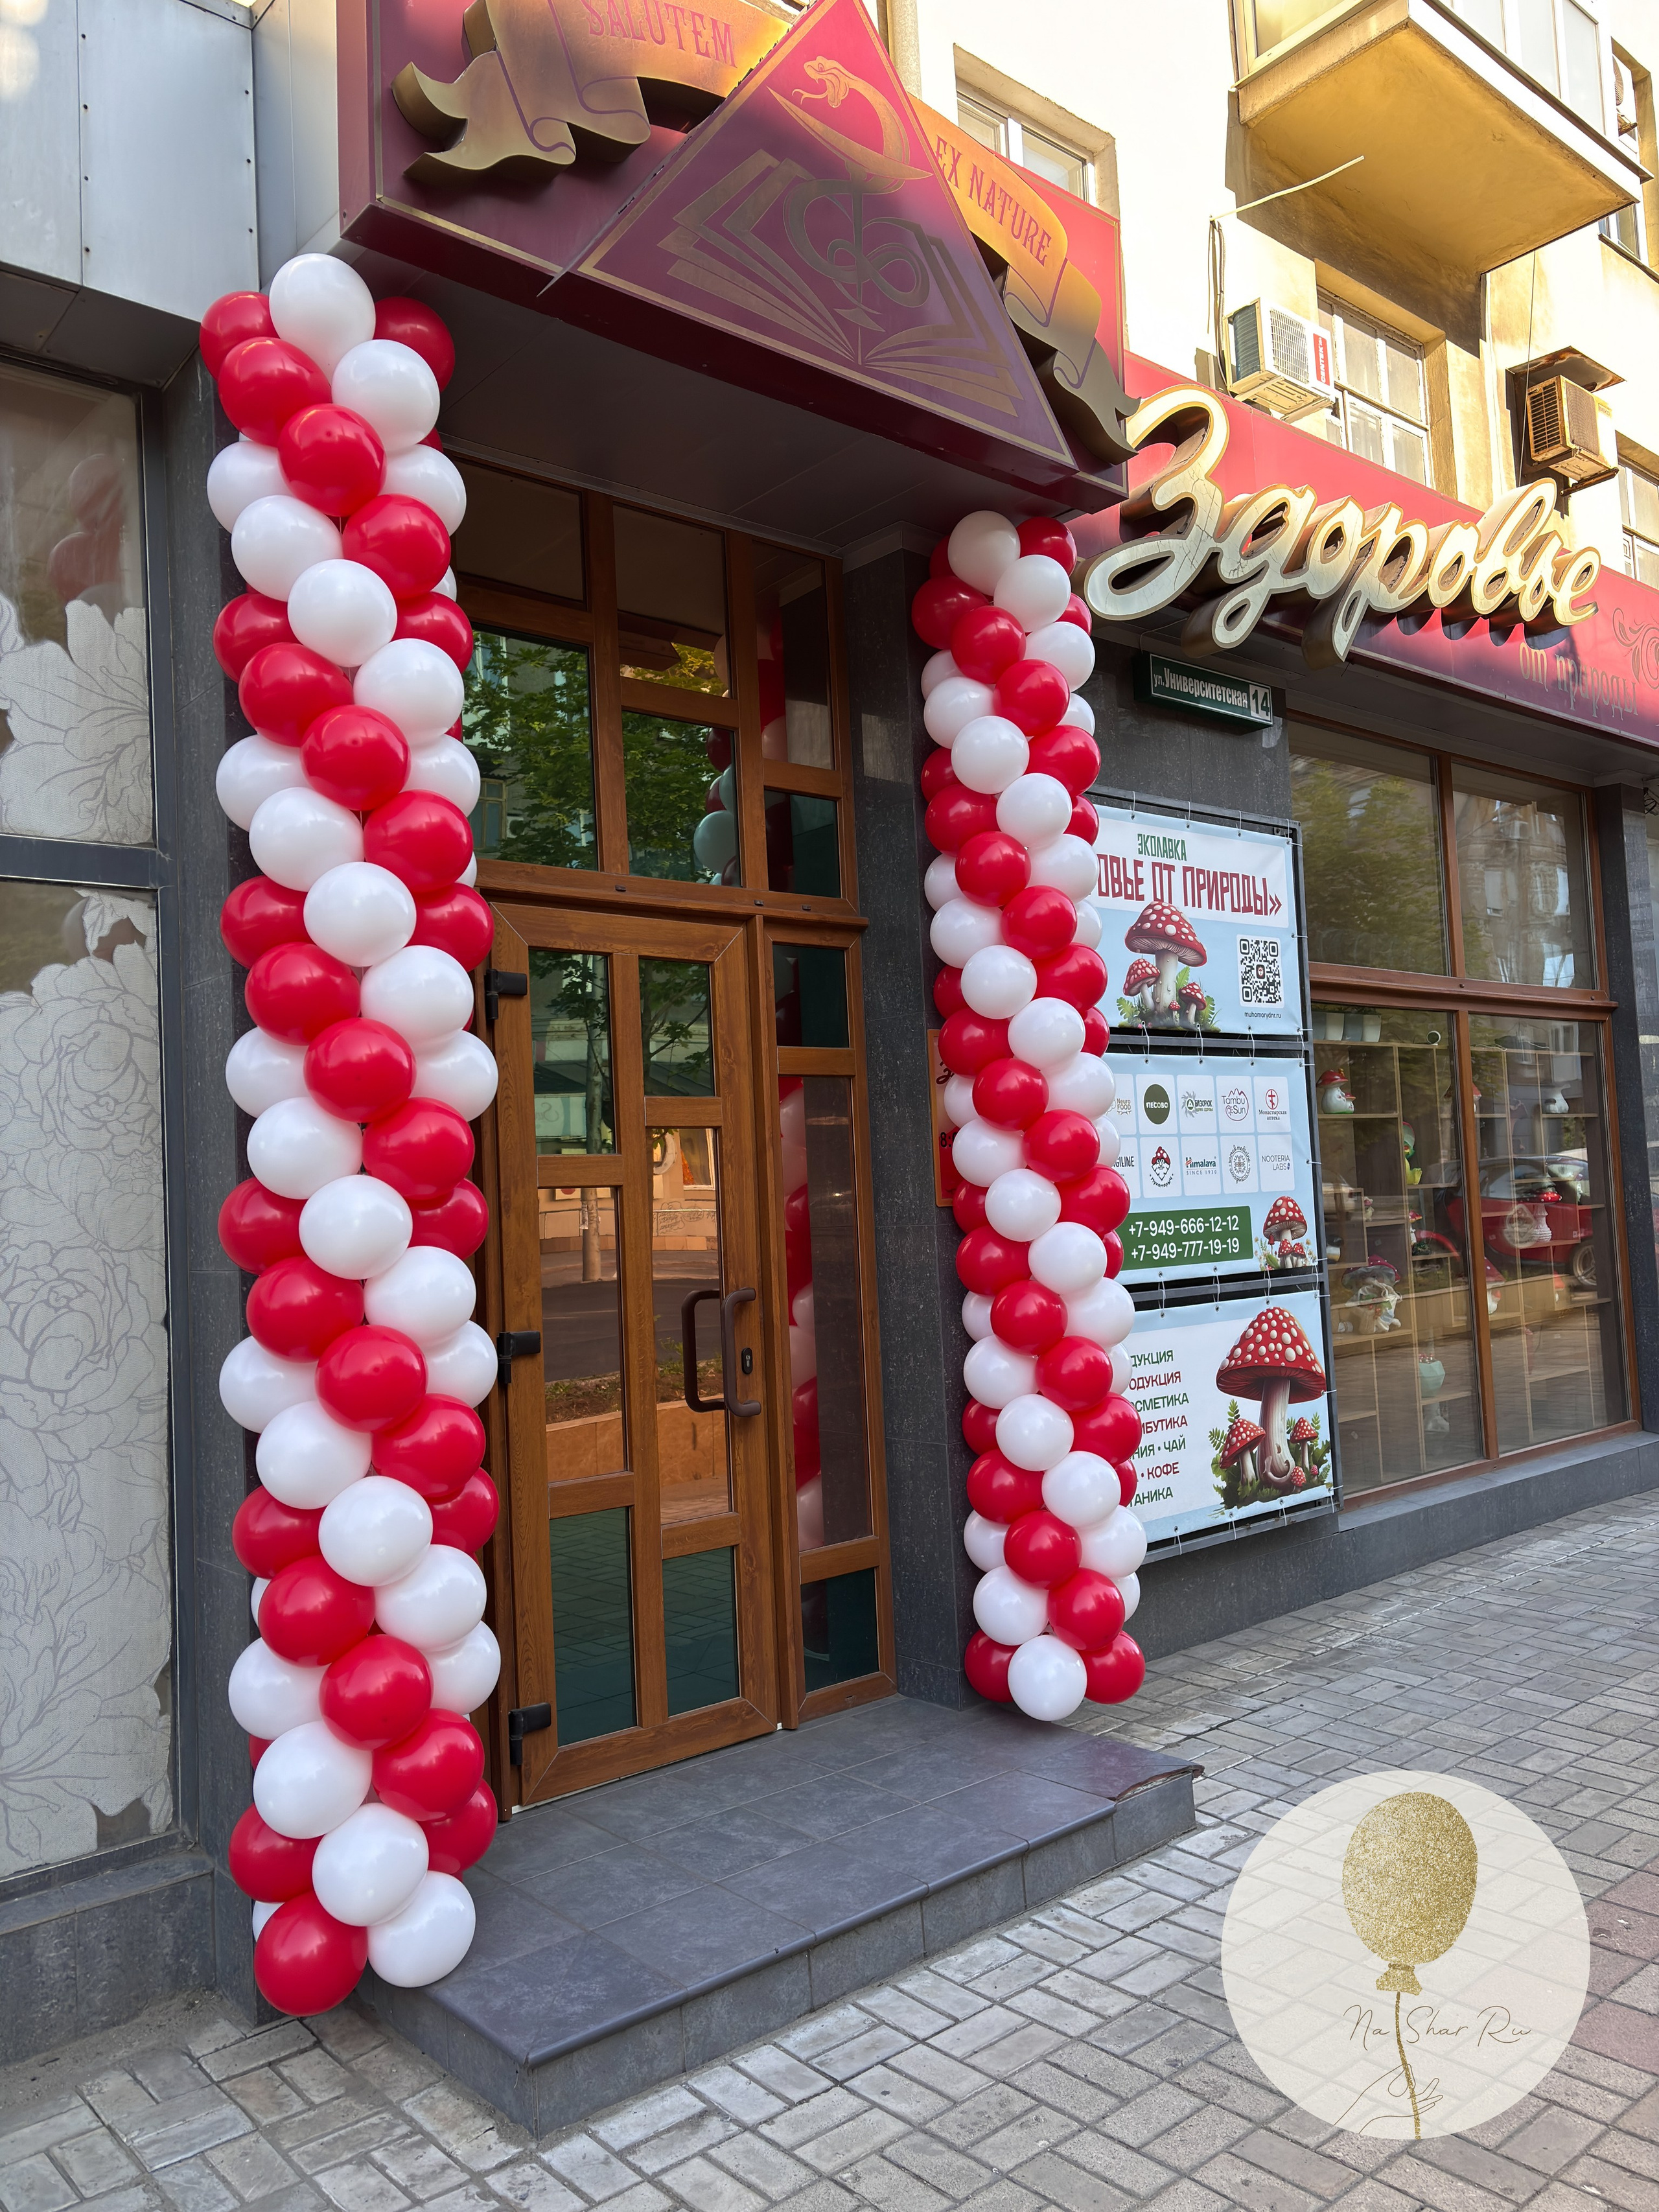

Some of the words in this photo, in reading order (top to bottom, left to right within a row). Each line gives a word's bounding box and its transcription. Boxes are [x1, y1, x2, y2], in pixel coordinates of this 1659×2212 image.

[582, 0, 737, 68] SALUTEM
[968, 162, 1052, 267] NATURE
[1084, 384, 1601, 662] Здоровье
[1555, 653, 1638, 721] природы
[1251, 689, 1271, 717] 14
[1137, 833, 1187, 861] ЭКОЛАВКА
[1096, 854, 1144, 902] ОВЬЕ
[1152, 862, 1175, 905] ОТ
[1244, 1011, 1281, 1020] muhomorydnr.ru
[1113, 1156, 1135, 1168] GILINE
[1185, 1156, 1216, 1168] Himalaya
[1262, 1154, 1290, 1163] NOOTERIA
[1272, 1163, 1287, 1171] LABS
[1129, 1215, 1239, 1238] +7-949-666-12-12
[1131, 1237, 1240, 1261] +7-949-777-19-19
[1130, 1349, 1174, 1368] ДУКЦИЯ
[1129, 1371, 1181, 1391] ОДУКЦИЯ
[1130, 1392, 1189, 1413] СМЕТИКА
[1163, 1434, 1186, 1452] ЧАЙ
[1146, 1461, 1180, 1480] КОФЕ
[1130, 1486, 1174, 1508] АНИКА
